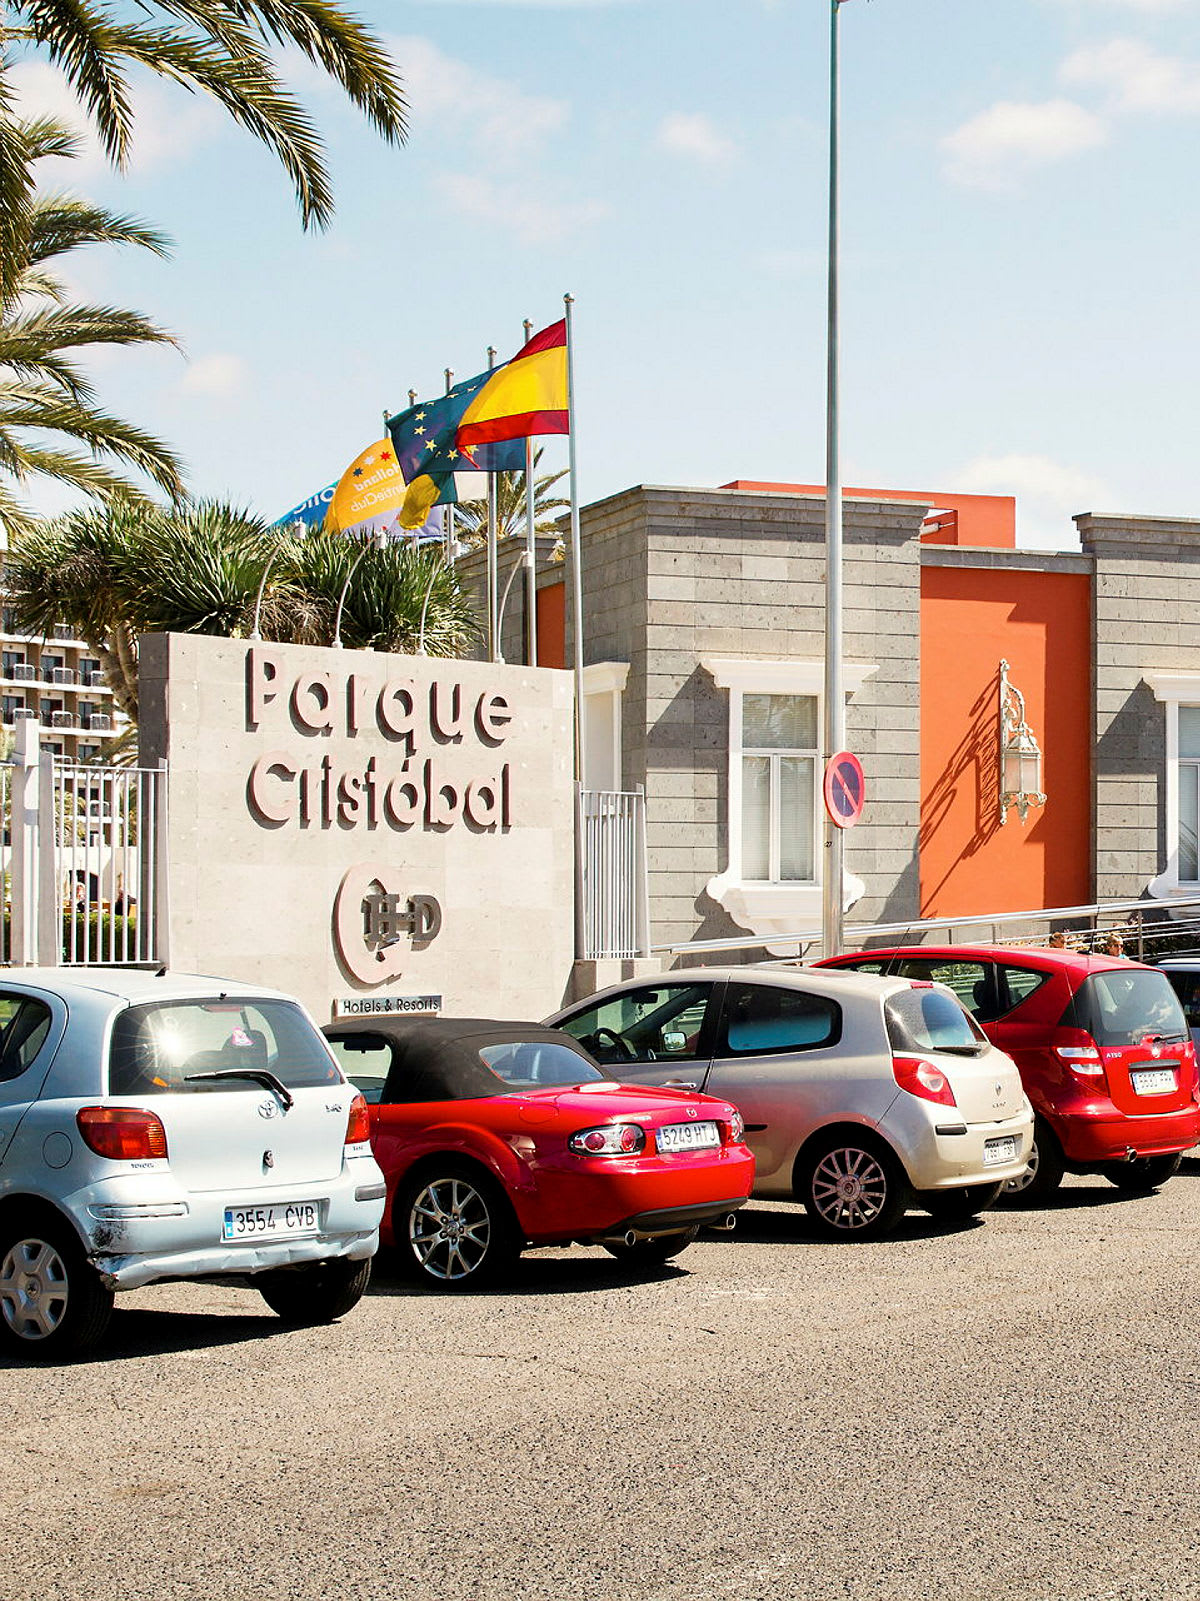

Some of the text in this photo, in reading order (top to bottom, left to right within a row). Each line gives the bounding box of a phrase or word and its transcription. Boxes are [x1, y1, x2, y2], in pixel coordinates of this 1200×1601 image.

[245, 647, 513, 758] Parque
[245, 750, 512, 834] Cristóbal
[343, 997, 439, 1013] Hotels & Resorts
[663, 1121, 716, 1146] 5249 HTJ
[236, 1205, 315, 1233] 3554 CVB
